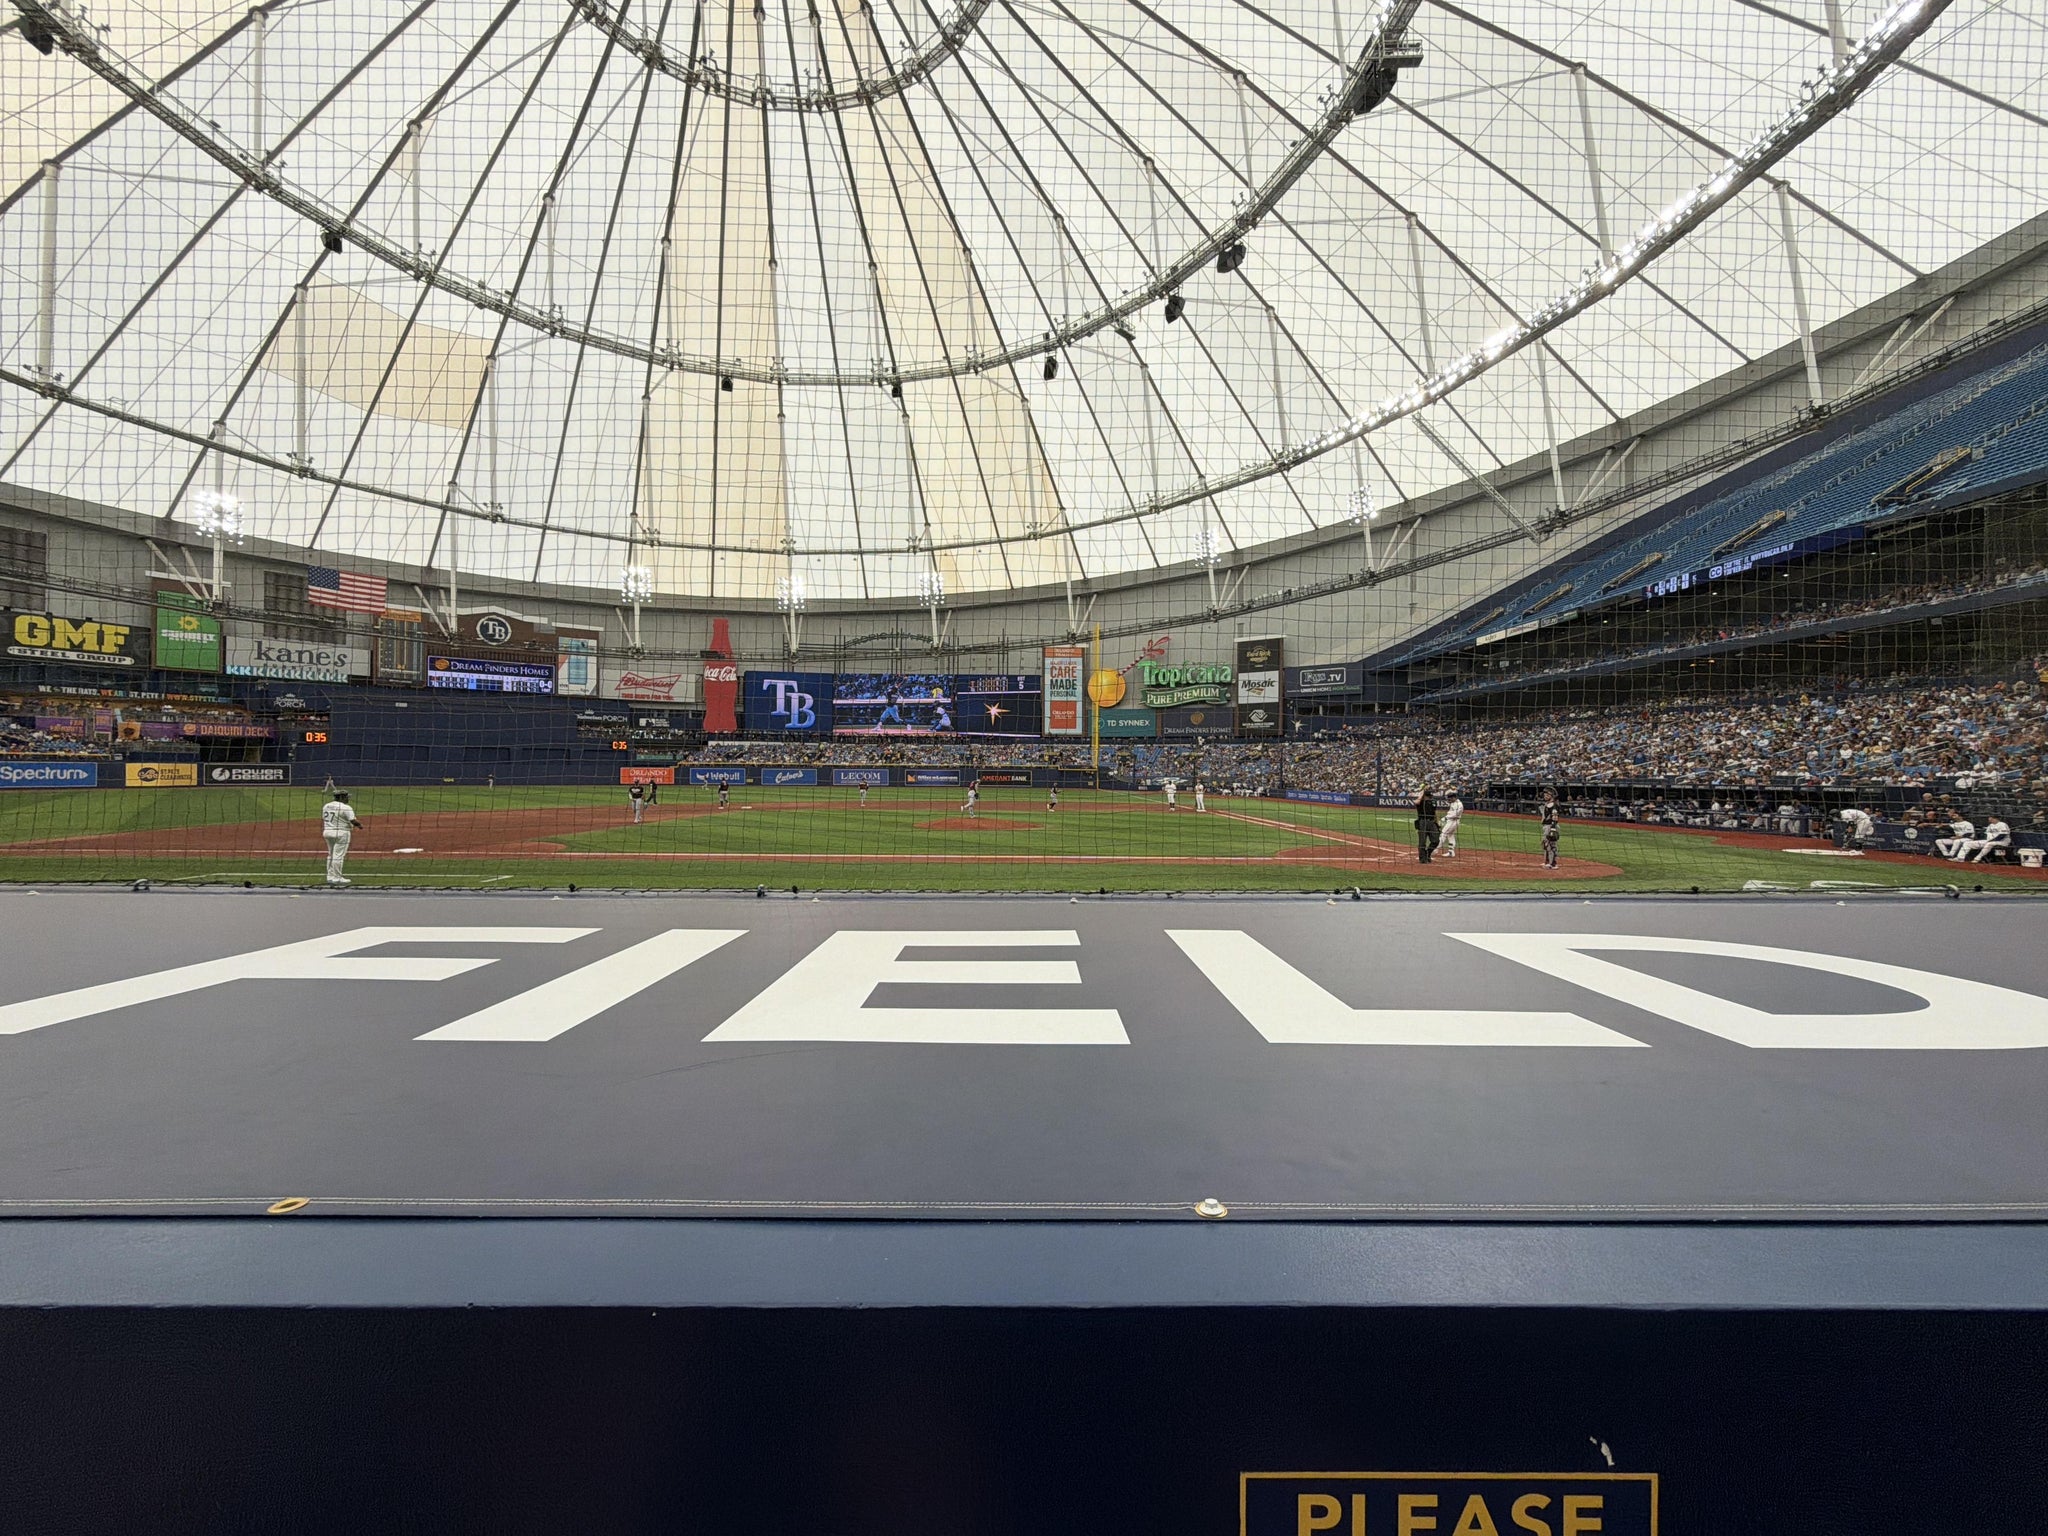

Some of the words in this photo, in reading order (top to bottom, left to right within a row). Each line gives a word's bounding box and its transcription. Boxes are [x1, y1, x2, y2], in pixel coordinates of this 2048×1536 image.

[15, 614, 130, 653] GMF
[483, 620, 506, 640] TB
[17, 648, 70, 659] STEEL
[76, 654, 127, 663] GROUP
[254, 640, 348, 668] kanes
[450, 661, 482, 672] DREAM
[520, 667, 549, 676] HOMES
[1050, 666, 1077, 679] CARE
[1137, 660, 1232, 688] Tropicana
[1050, 679, 1077, 690] MADE
[1241, 679, 1275, 689] Mosaic
[1147, 693, 1173, 705] PURE
[1174, 687, 1219, 702] PREMIUM
[274, 701, 305, 709] PORCH
[762, 679, 816, 729] TB
[603, 714, 628, 722] PORCH
[1119, 719, 1150, 727] SYNNEX
[245, 727, 270, 737] DECK
[0, 766, 83, 782] Spectrum
[710, 771, 740, 780] Webull
[1379, 798, 1415, 806] RAYMON
[323, 811, 336, 823] 27
[0, 926, 2048, 1050] FIELD
[1297, 1493, 1603, 1536] PLEASE
